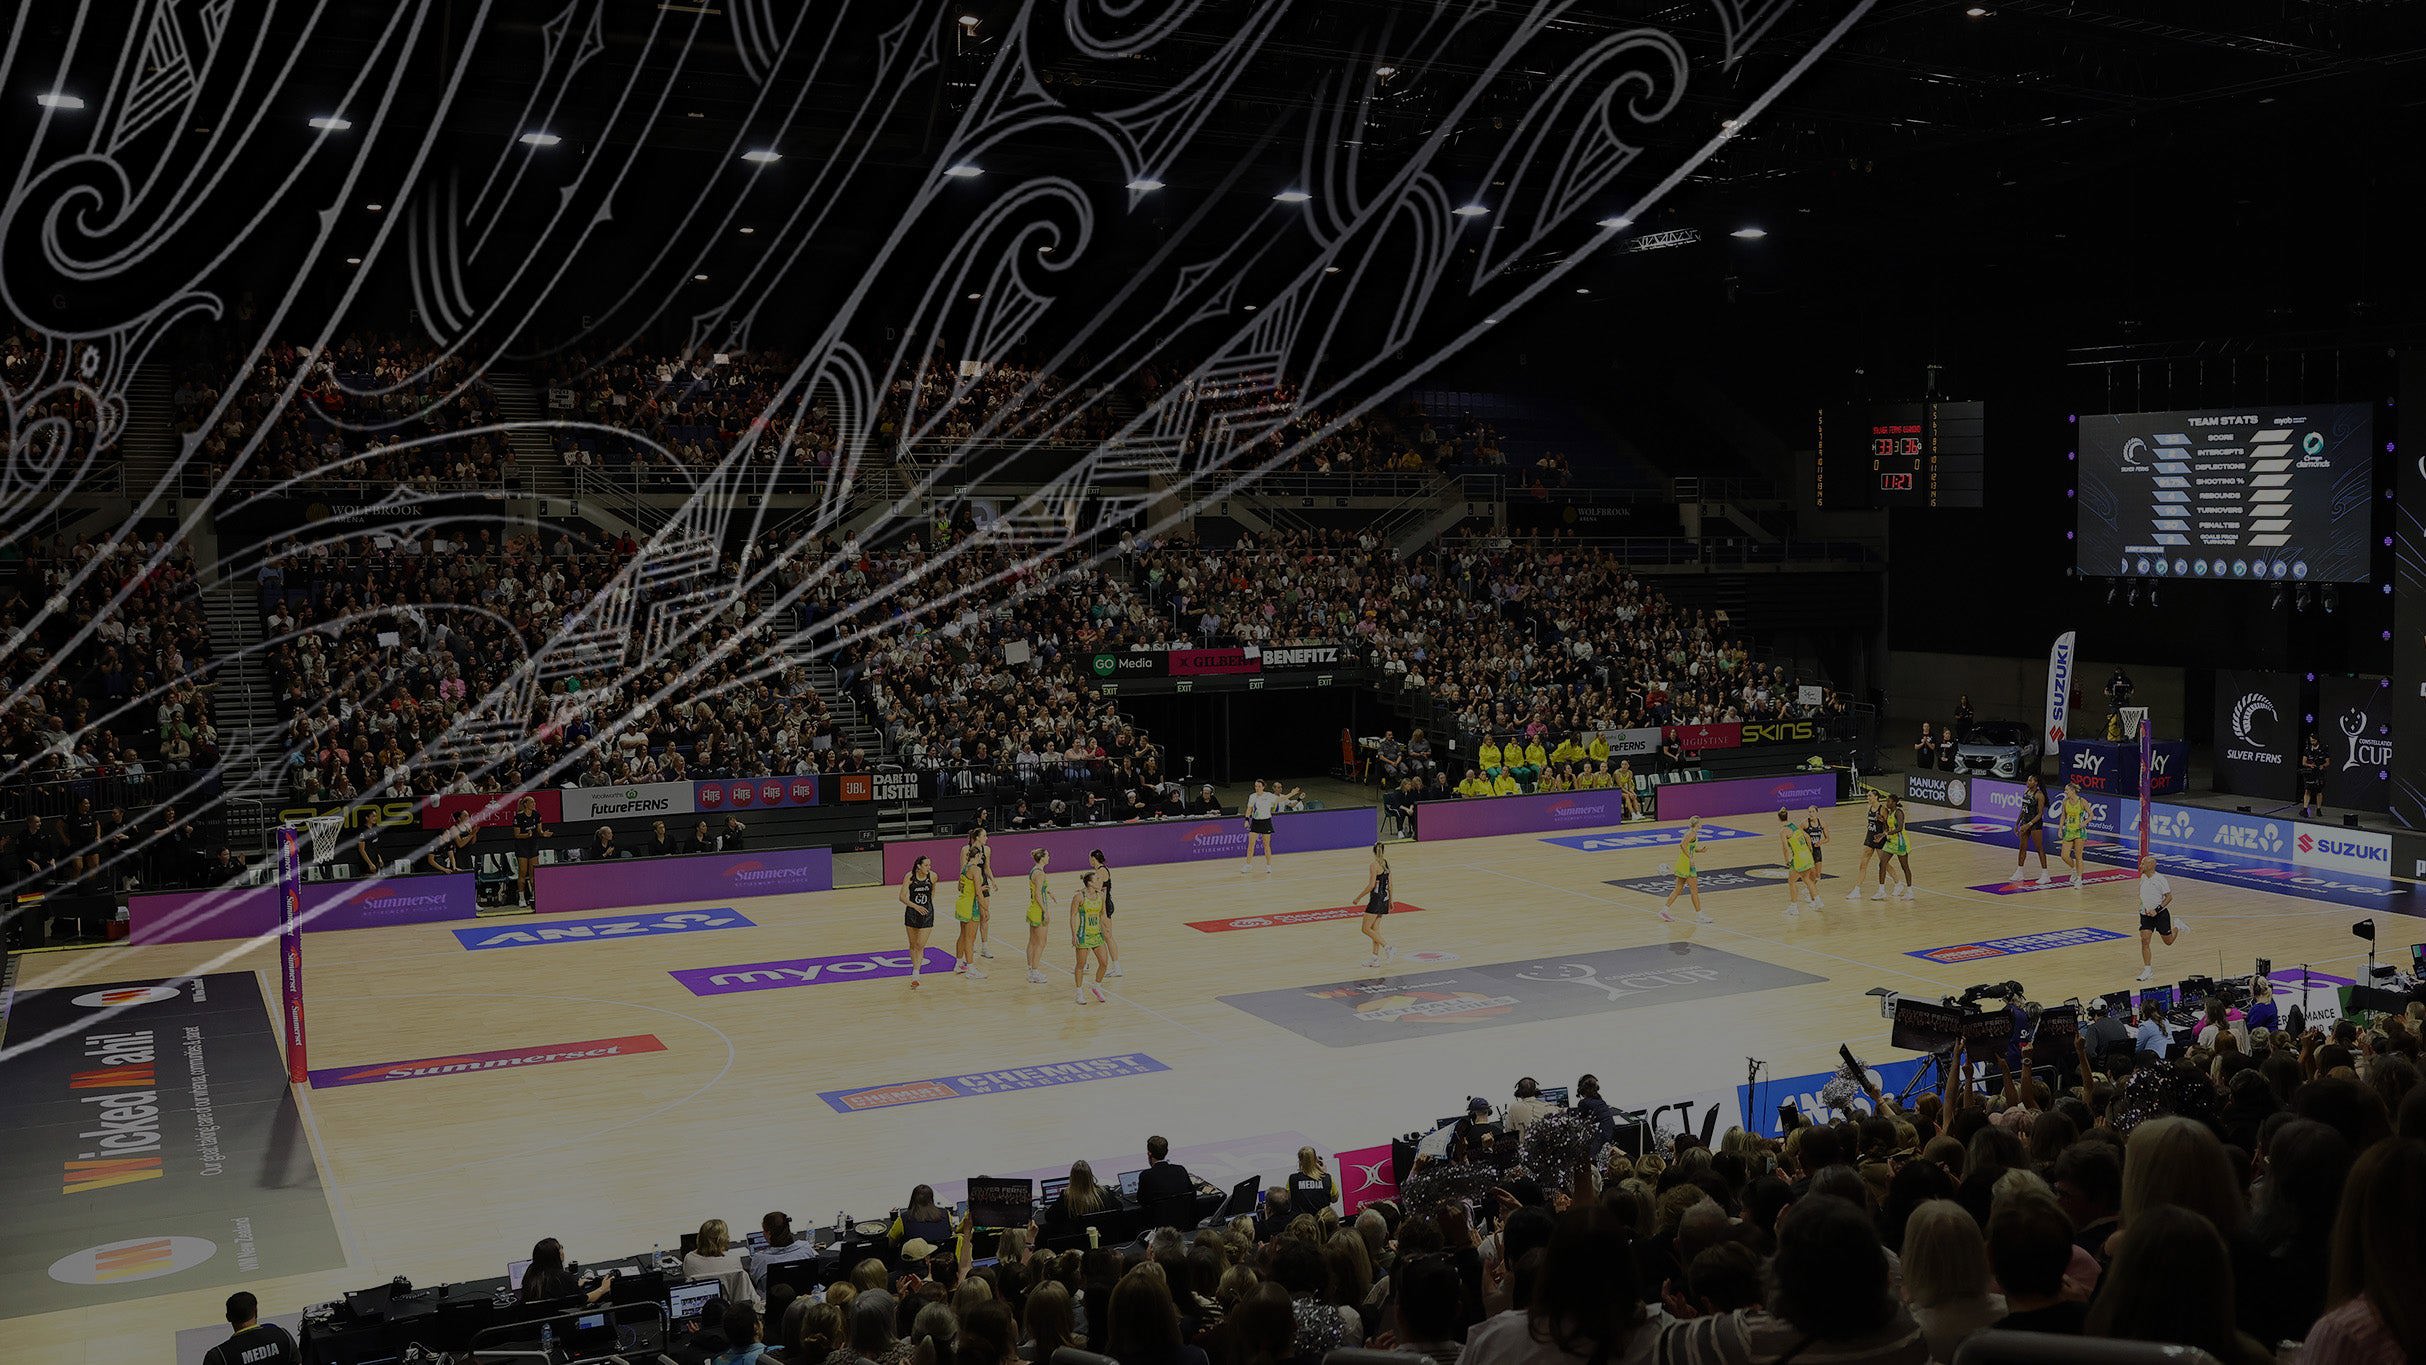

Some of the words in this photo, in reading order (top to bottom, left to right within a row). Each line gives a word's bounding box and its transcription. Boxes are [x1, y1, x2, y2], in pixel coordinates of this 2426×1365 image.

[2188, 417, 2219, 426] TEAM
[2220, 415, 2258, 425] STATS
[1879, 439, 1892, 454] 33
[1577, 506, 1631, 516] WOLFBROOK
[1095, 658, 1114, 669] GO
[1119, 657, 1153, 669] Media
[1263, 647, 1337, 665] BENEFITZ
[1177, 683, 1193, 693] EXIT
[1250, 680, 1265, 690] EXIT
[1318, 676, 1333, 687] EXIT
[2051, 643, 2068, 722] SUZUKI
[1102, 686, 1118, 696] EXIT
[1682, 736, 1728, 747] UGUSTINE
[2072, 748, 2105, 775] sky
[2227, 749, 2253, 761] SILVER
[2255, 752, 2282, 765] FERNS
[2358, 745, 2392, 766] CUP
[873, 774, 903, 785] DARE
[904, 773, 918, 783] TO
[1909, 776, 1946, 790] MANUKA
[2070, 774, 2106, 789] SPORT
[846, 782, 866, 794] JBL
[873, 783, 918, 800] LISTEN
[1776, 785, 1822, 798] Summerset
[1909, 787, 1946, 802] DOCTOR
[591, 798, 669, 817] futureFERNS
[1991, 791, 2023, 809] myob
[1554, 803, 1605, 816] Summerset
[2213, 824, 2258, 850] ANZ
[2318, 838, 2388, 862] SUZUKI
[735, 865, 808, 882] Summerset
[363, 892, 447, 910] Summerset
[476, 921, 652, 946] ANZ
[709, 956, 931, 986] myob
[69, 1030, 156, 1089] Mahi!
[386, 1043, 622, 1081] Summerset
[957, 1055, 1138, 1088] CHEMIST
[63, 1090, 163, 1194] Wicked
[199, 1162, 223, 1177] Our
[1298, 1180, 1323, 1190] MEDIA
[241, 1342, 280, 1365] MEDIA
